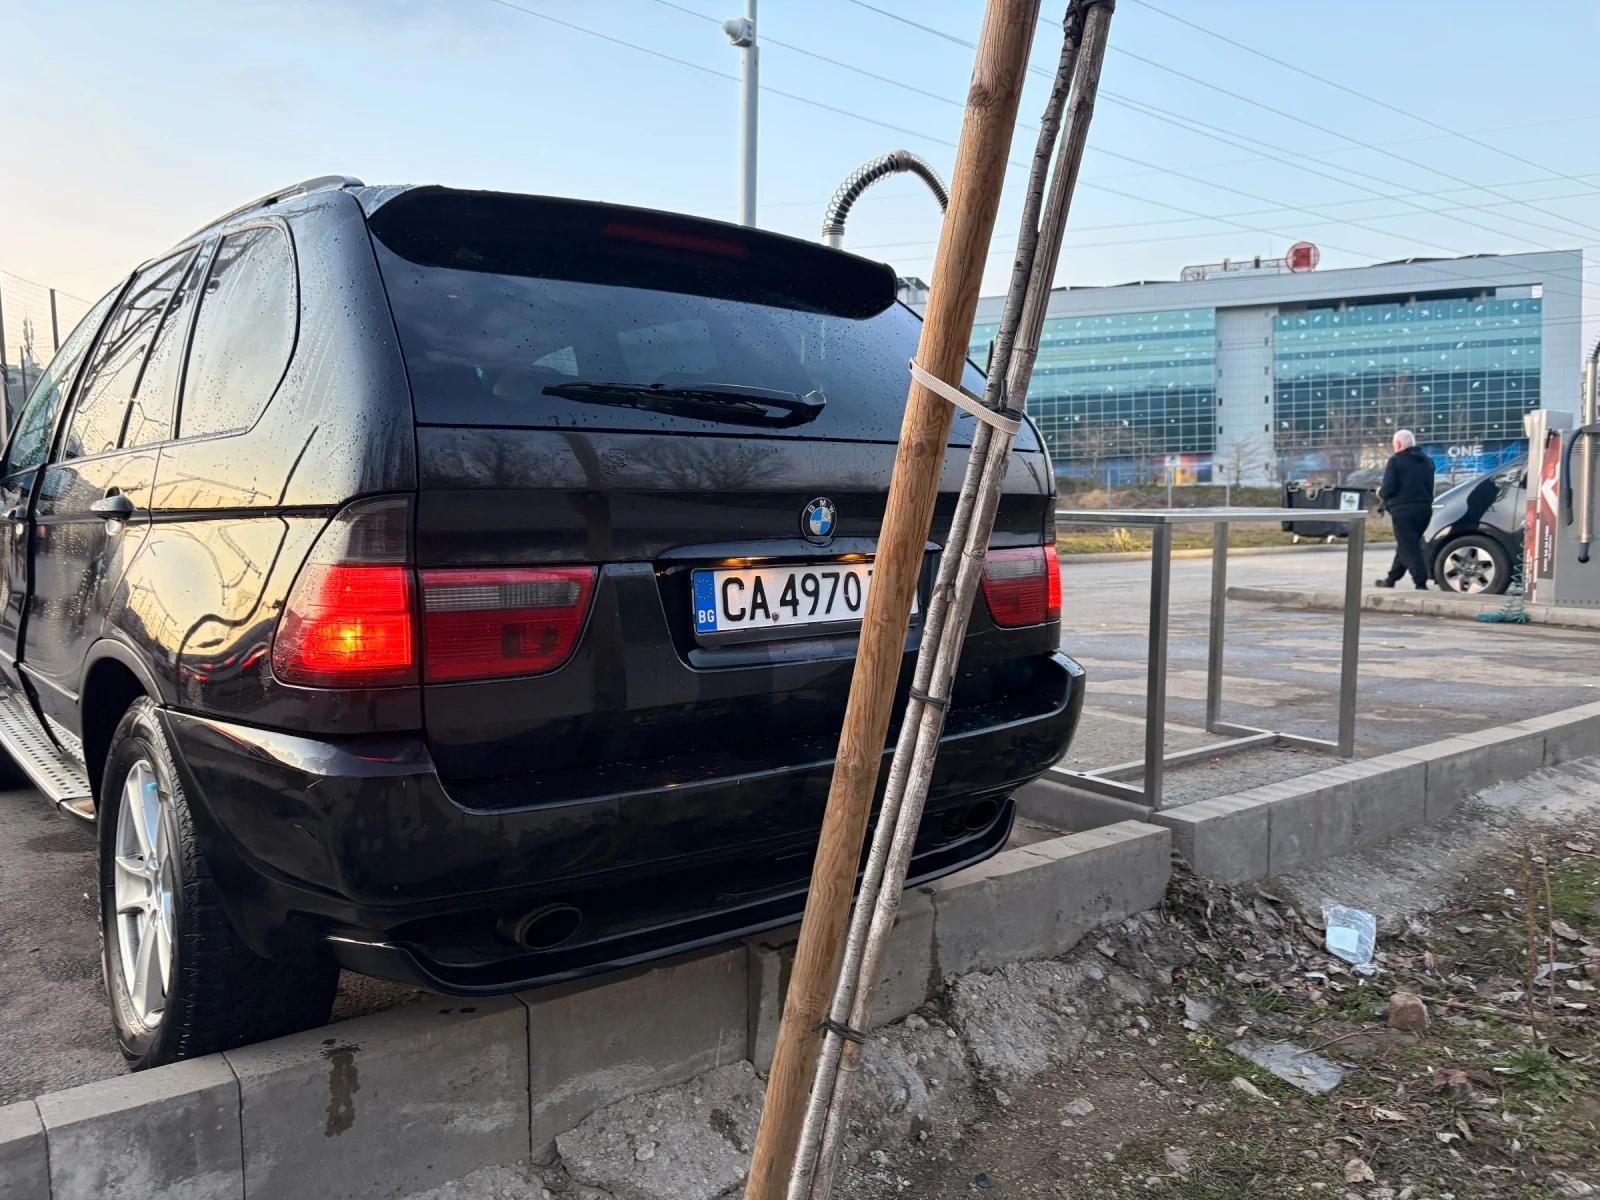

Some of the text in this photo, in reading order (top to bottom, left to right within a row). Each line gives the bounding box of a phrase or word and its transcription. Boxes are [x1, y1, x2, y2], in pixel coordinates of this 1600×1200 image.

[1448, 445, 1484, 457] ONE
[807, 499, 835, 514] BMW
[698, 609, 715, 623] BG
